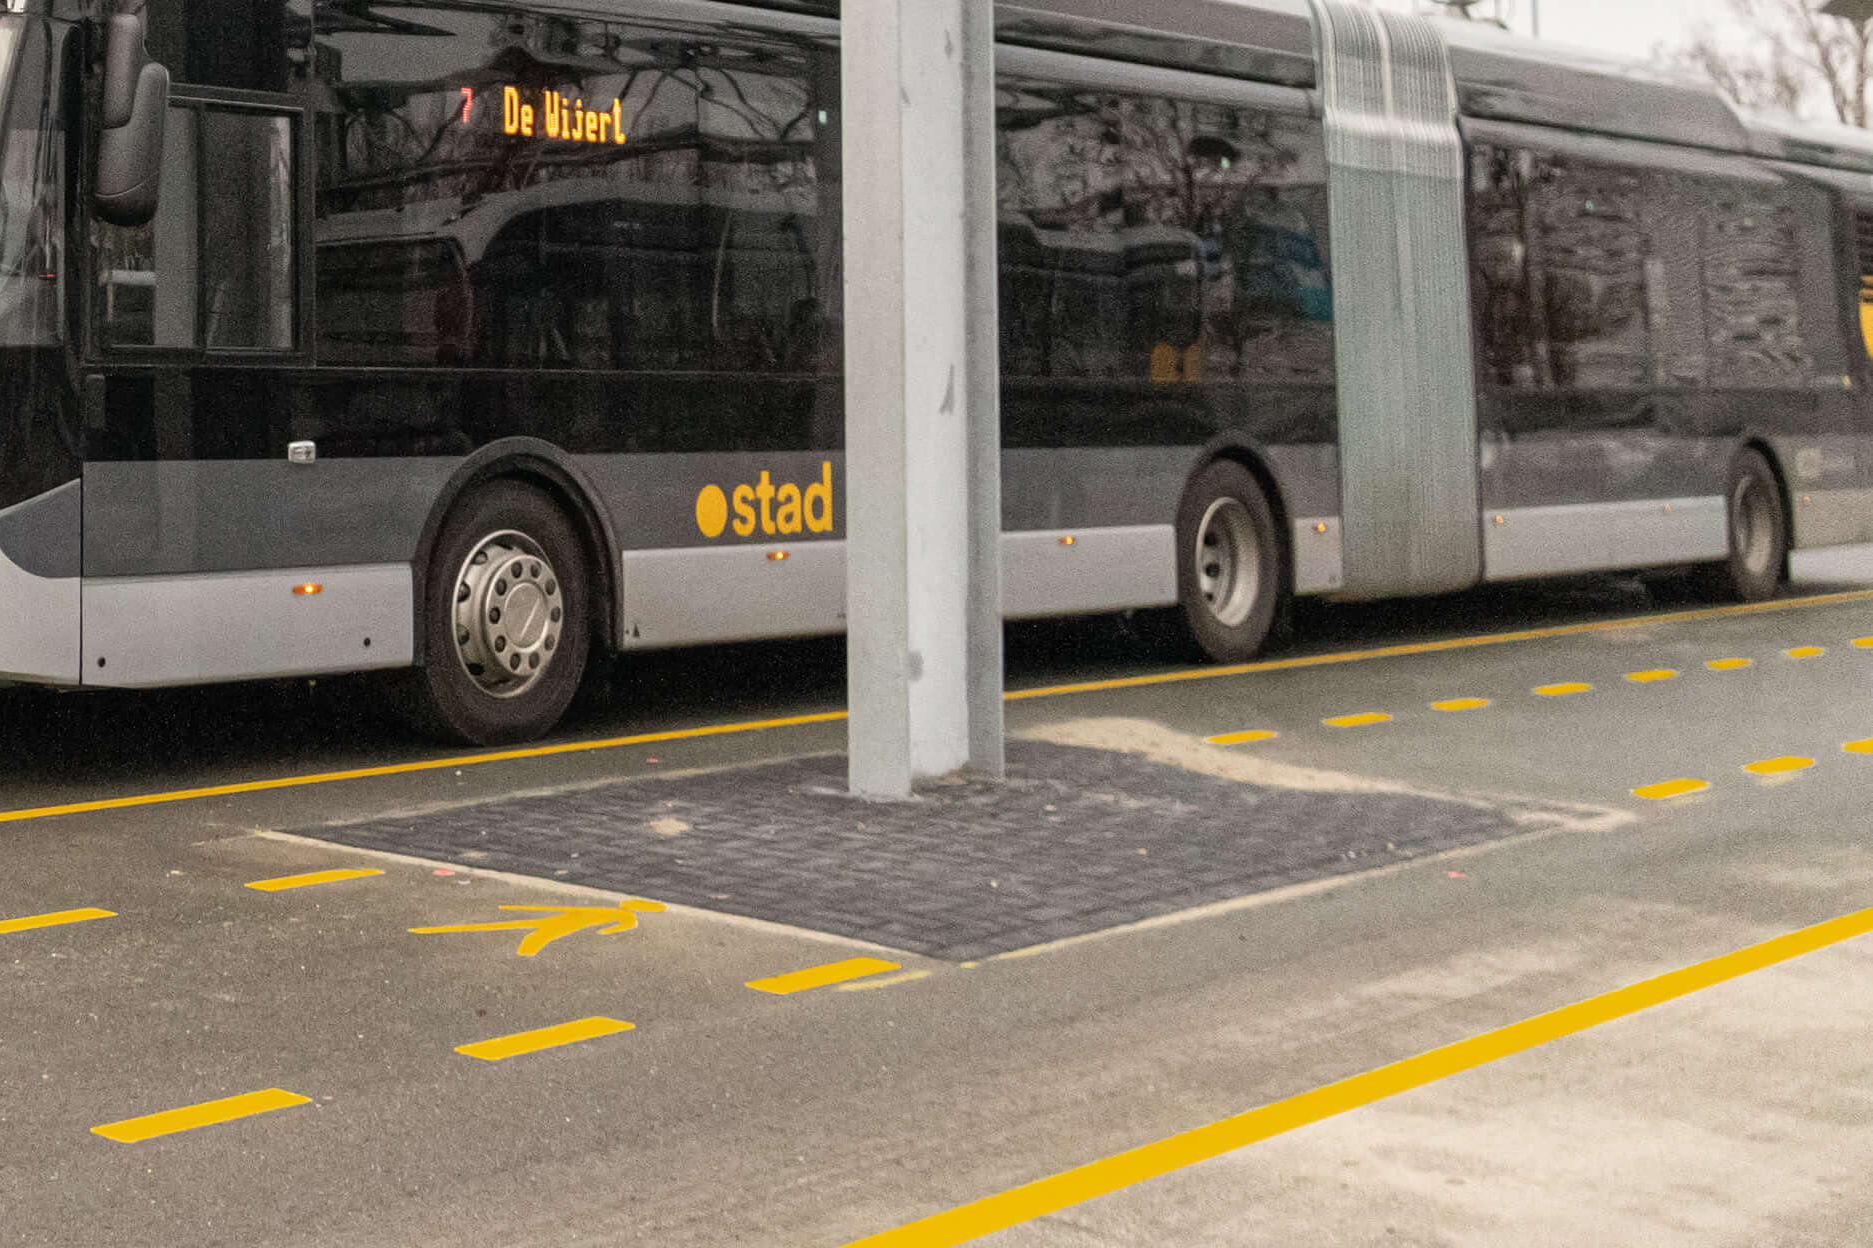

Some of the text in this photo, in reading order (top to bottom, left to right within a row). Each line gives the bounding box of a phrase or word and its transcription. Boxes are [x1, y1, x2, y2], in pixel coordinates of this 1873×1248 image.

[461, 85, 626, 145] 7 De Wijert
[732, 461, 833, 537] stad
